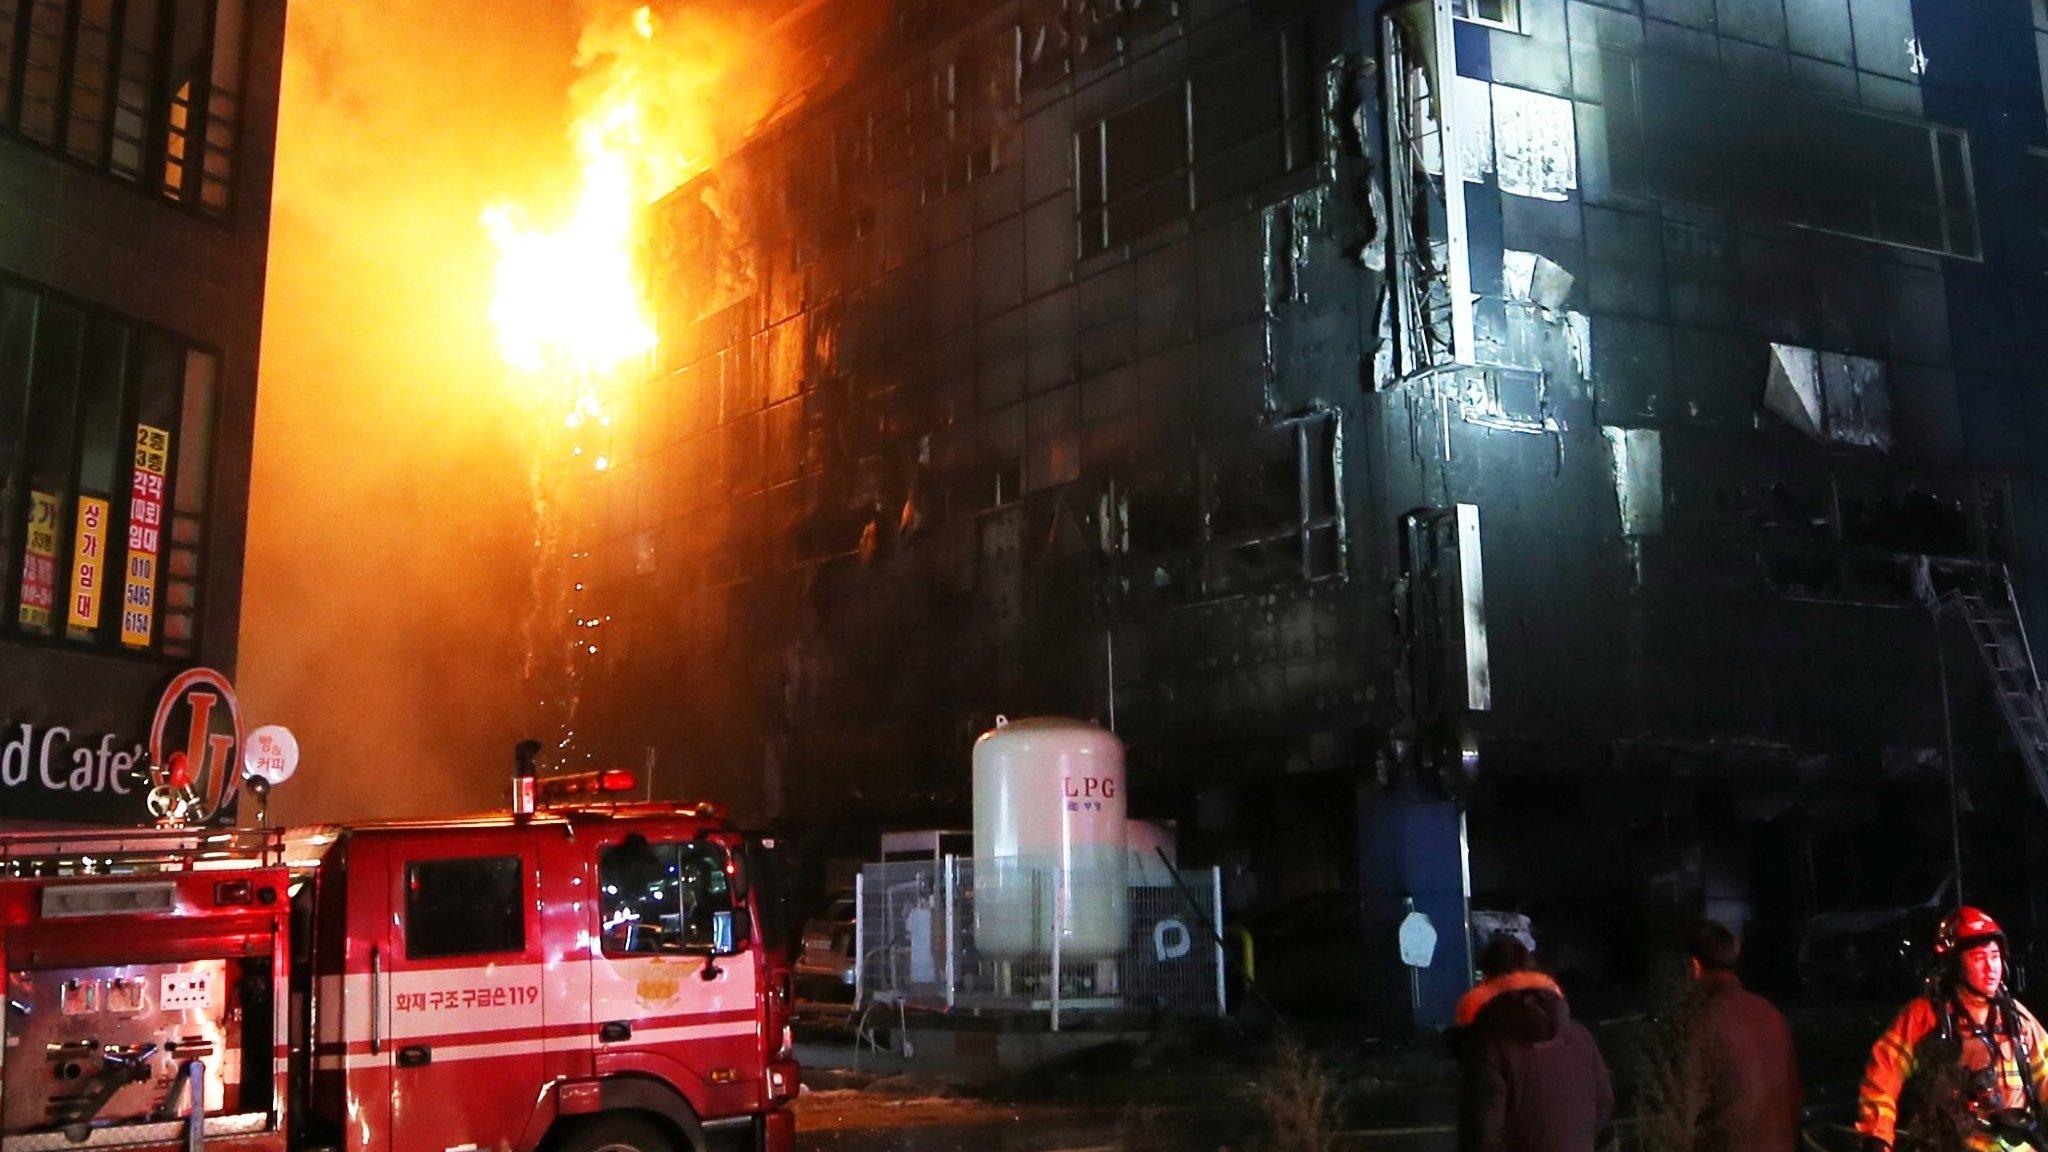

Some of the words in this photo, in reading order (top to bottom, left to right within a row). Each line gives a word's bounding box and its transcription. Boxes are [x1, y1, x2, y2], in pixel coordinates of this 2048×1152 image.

[134, 471, 162, 499] 각각
[129, 524, 158, 553] 임대
[131, 556, 151, 579] 010
[257, 757, 284, 772] 커피
[1065, 776, 1115, 798] LPG
[396, 992, 426, 1012] 화재
[430, 990, 459, 1010] 구조
